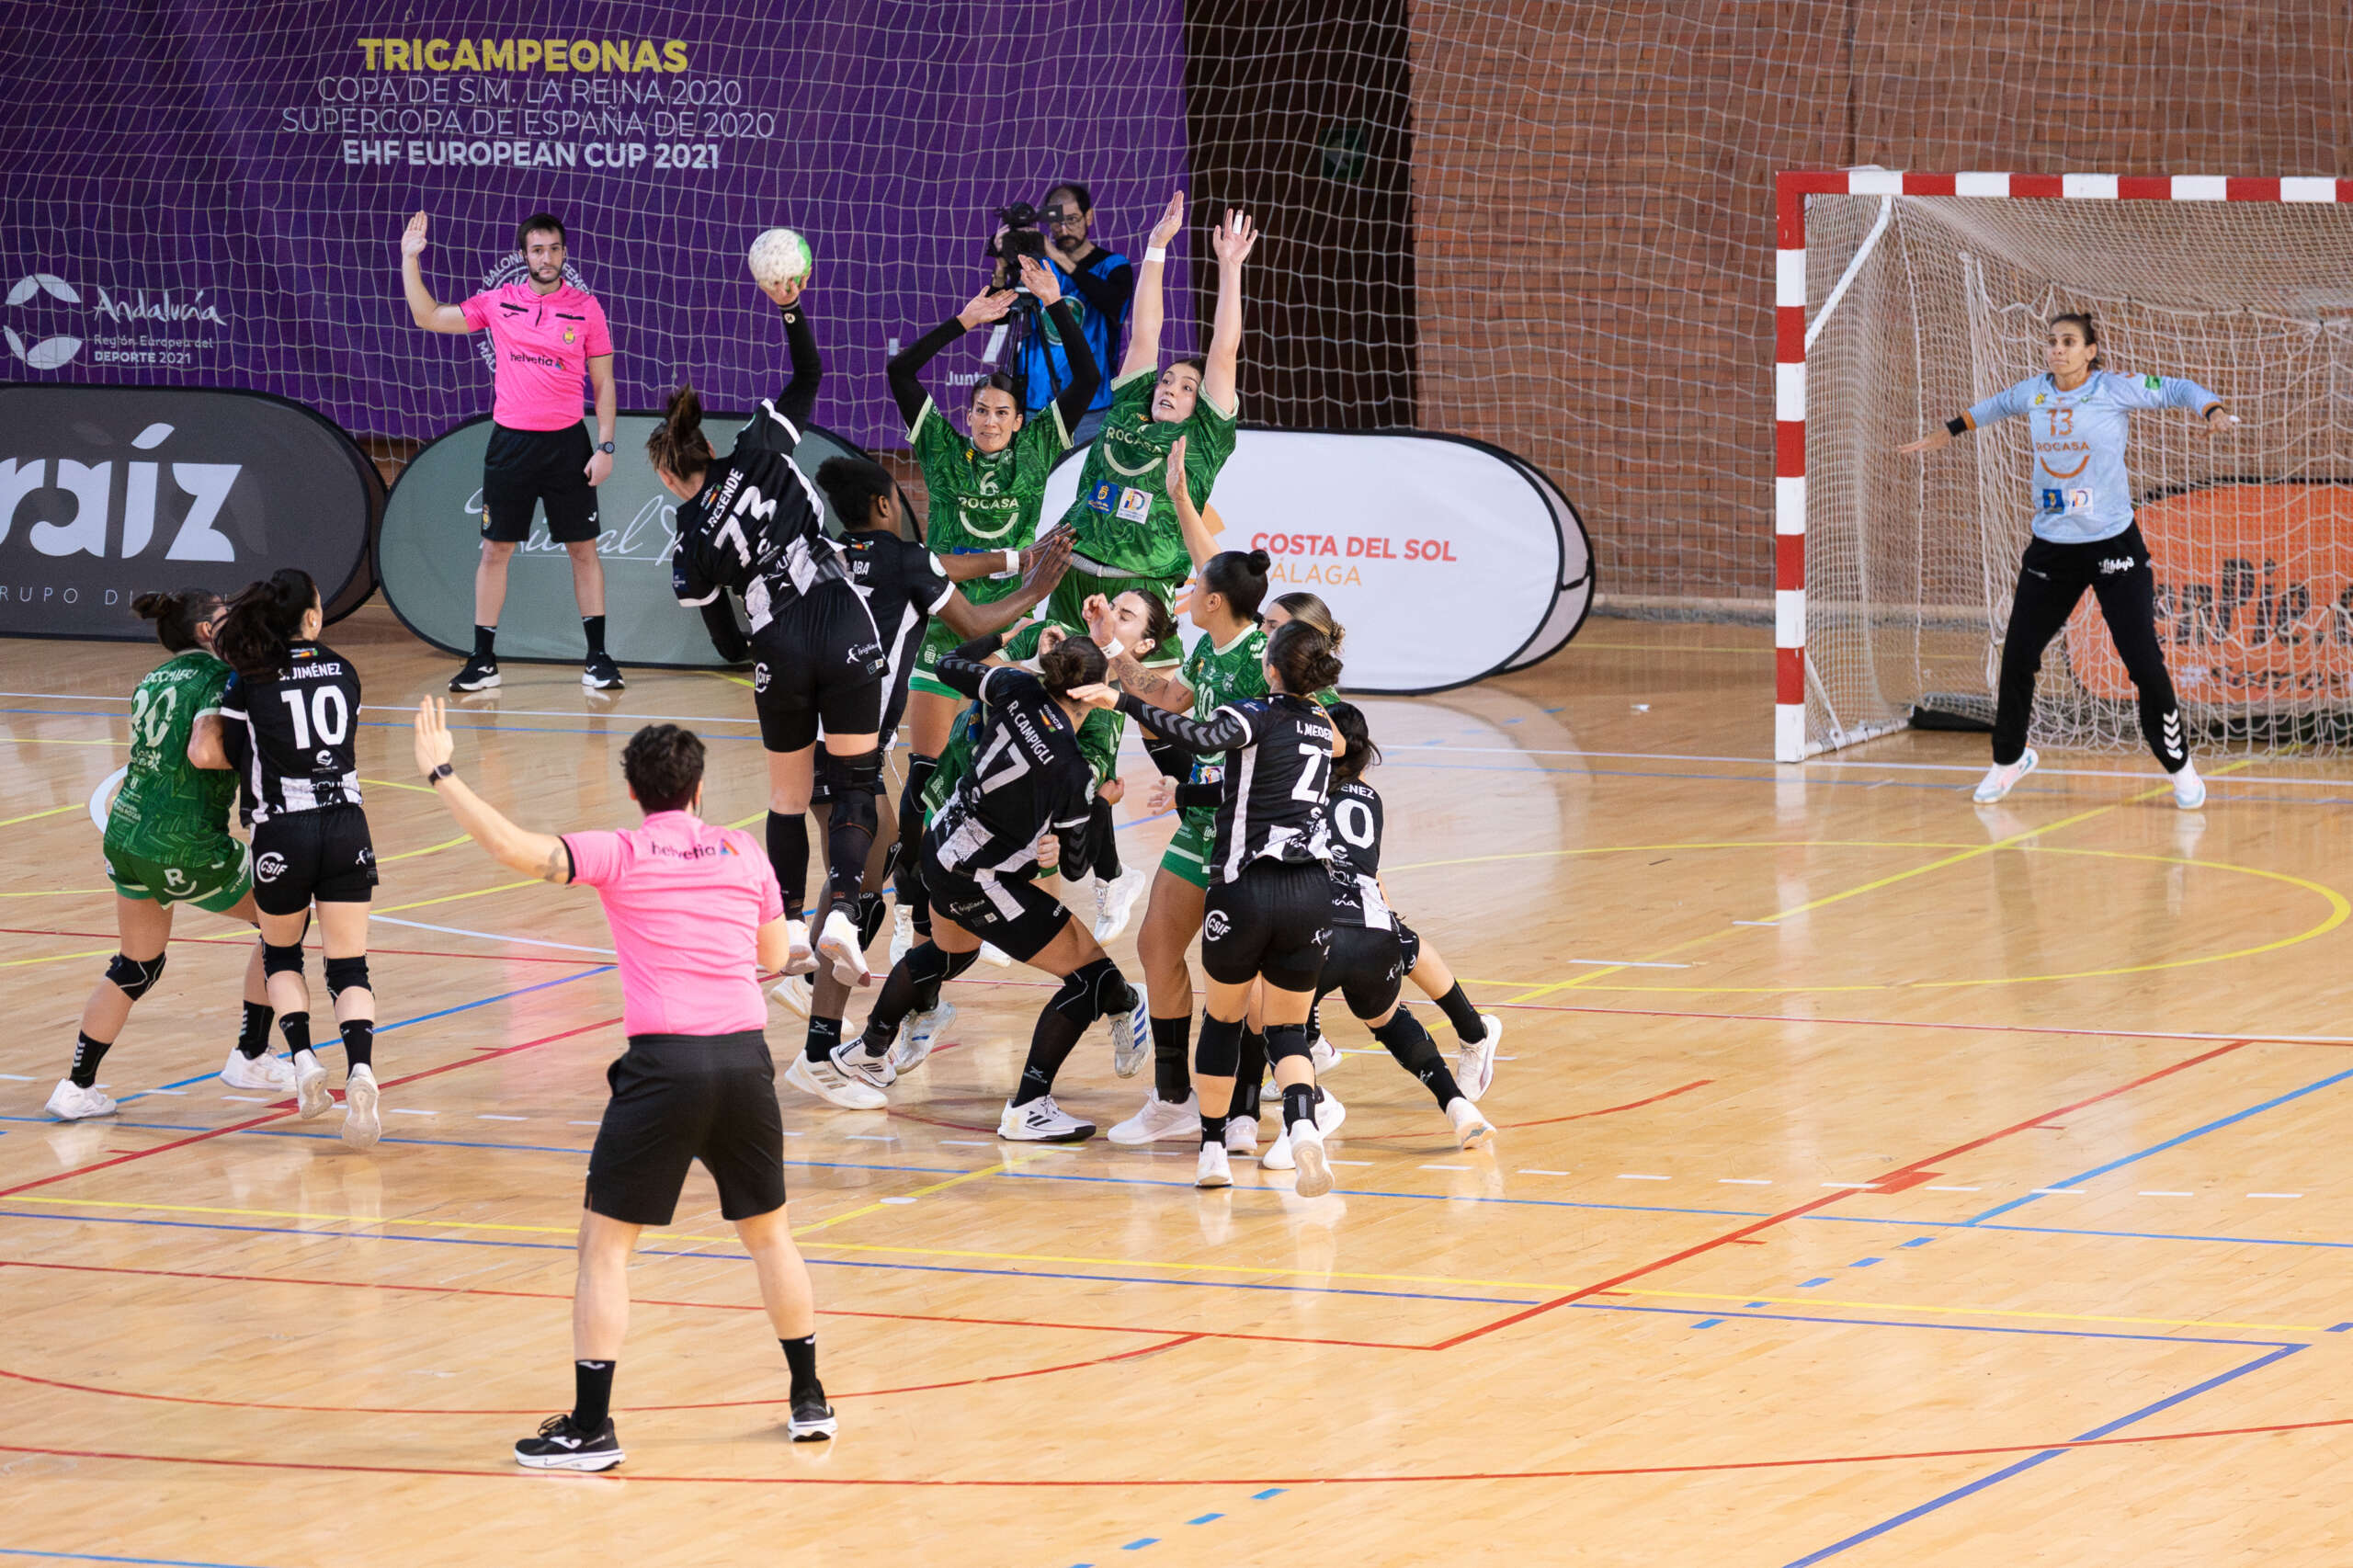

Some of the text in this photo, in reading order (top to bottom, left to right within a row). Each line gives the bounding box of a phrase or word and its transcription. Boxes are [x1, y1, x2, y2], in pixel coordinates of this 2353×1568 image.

[358, 39, 688, 73] TRICAMPEONAS
[318, 76, 741, 106] COPA DE S.M. LA REINA 2020
[282, 105, 774, 138] SUPERCOPA DE ESPAÑA DE 2020
[343, 139, 719, 169] EHF EUROPEAN CUP 2021
[94, 286, 228, 326] Andalucía
[94, 334, 134, 348] Región
[140, 335, 190, 349] Europea
[95, 350, 191, 364] DEPORTE 2021
[510, 351, 553, 367] helvetia
[945, 370, 988, 387] Junt
[2046, 408, 2075, 437] 13
[2035, 441, 2091, 452] ROCASA
[979, 471, 1000, 496] 6
[1250, 532, 1458, 562] COSTA DEL SOL
[1269, 557, 1363, 587] ÁLAGA
[292, 663, 343, 680] JIMÉNEZ
[280, 685, 348, 750] 10
[1006, 699, 1019, 716] R.
[1014, 712, 1055, 766] CAMPIGLI
[975, 722, 1031, 795] 17
[651, 840, 716, 861] helvetia
[260, 861, 289, 876] CSIF
[1208, 919, 1232, 935] CSIF
